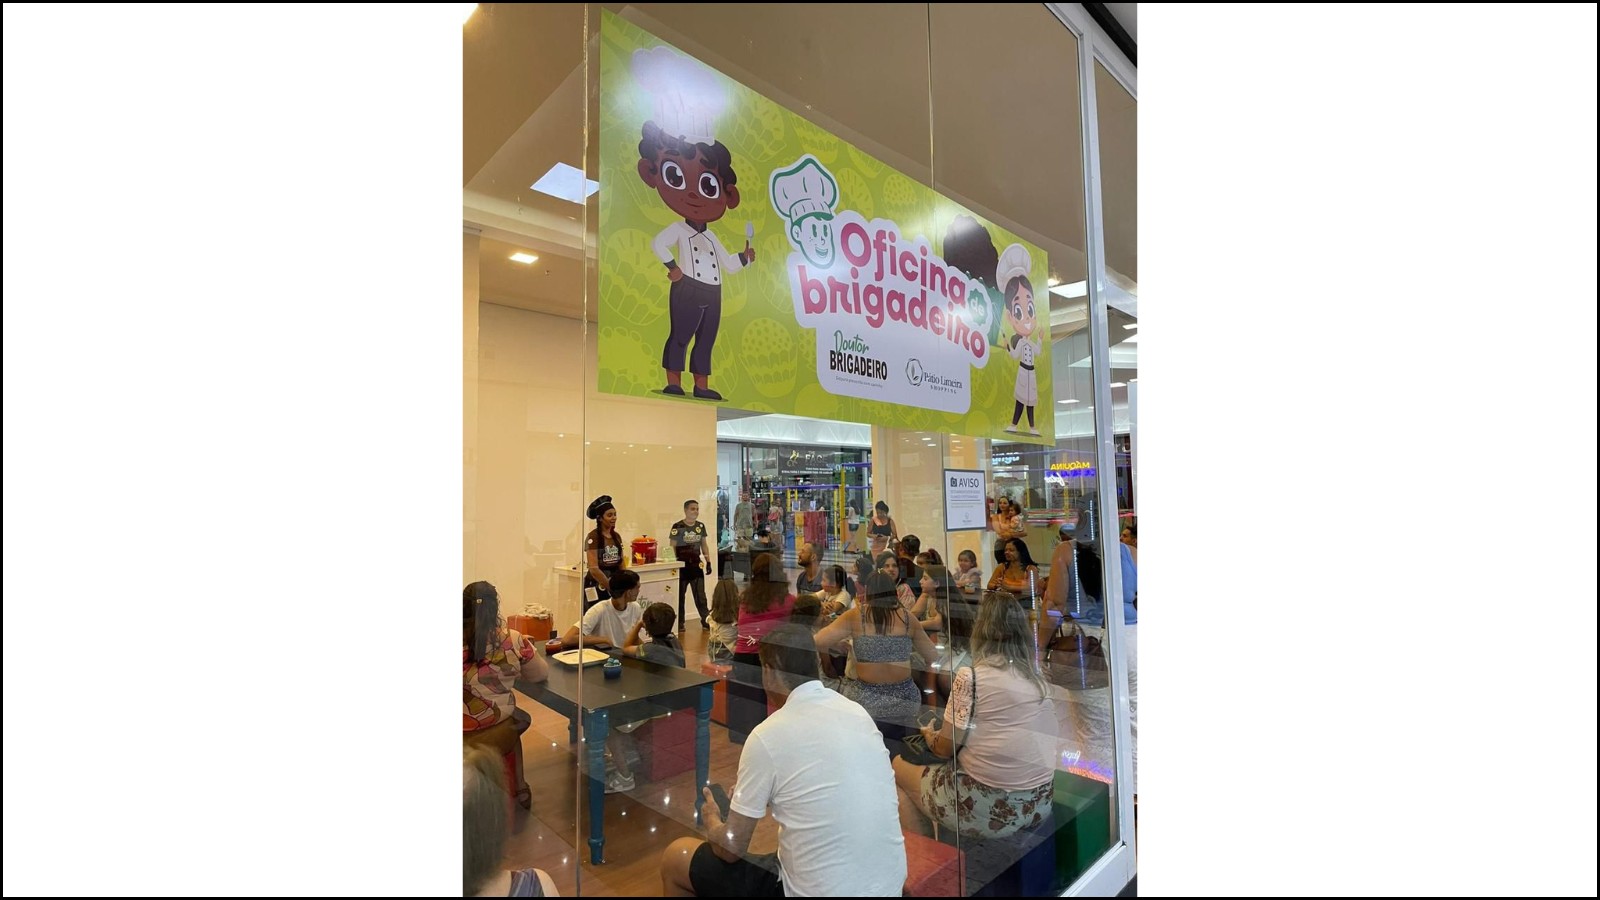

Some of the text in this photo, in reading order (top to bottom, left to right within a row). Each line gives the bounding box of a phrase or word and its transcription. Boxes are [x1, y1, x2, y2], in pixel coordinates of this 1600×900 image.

[840, 222, 966, 306] Oficina
[798, 265, 986, 358] brigadeiro
[970, 298, 985, 316] de
[833, 330, 869, 354] Doutor
[829, 350, 888, 381] BRIGADEIRO
[924, 371, 963, 388] Pátio Limeira
[930, 384, 957, 394] SHOPPING
[959, 477, 980, 488] AVISO
